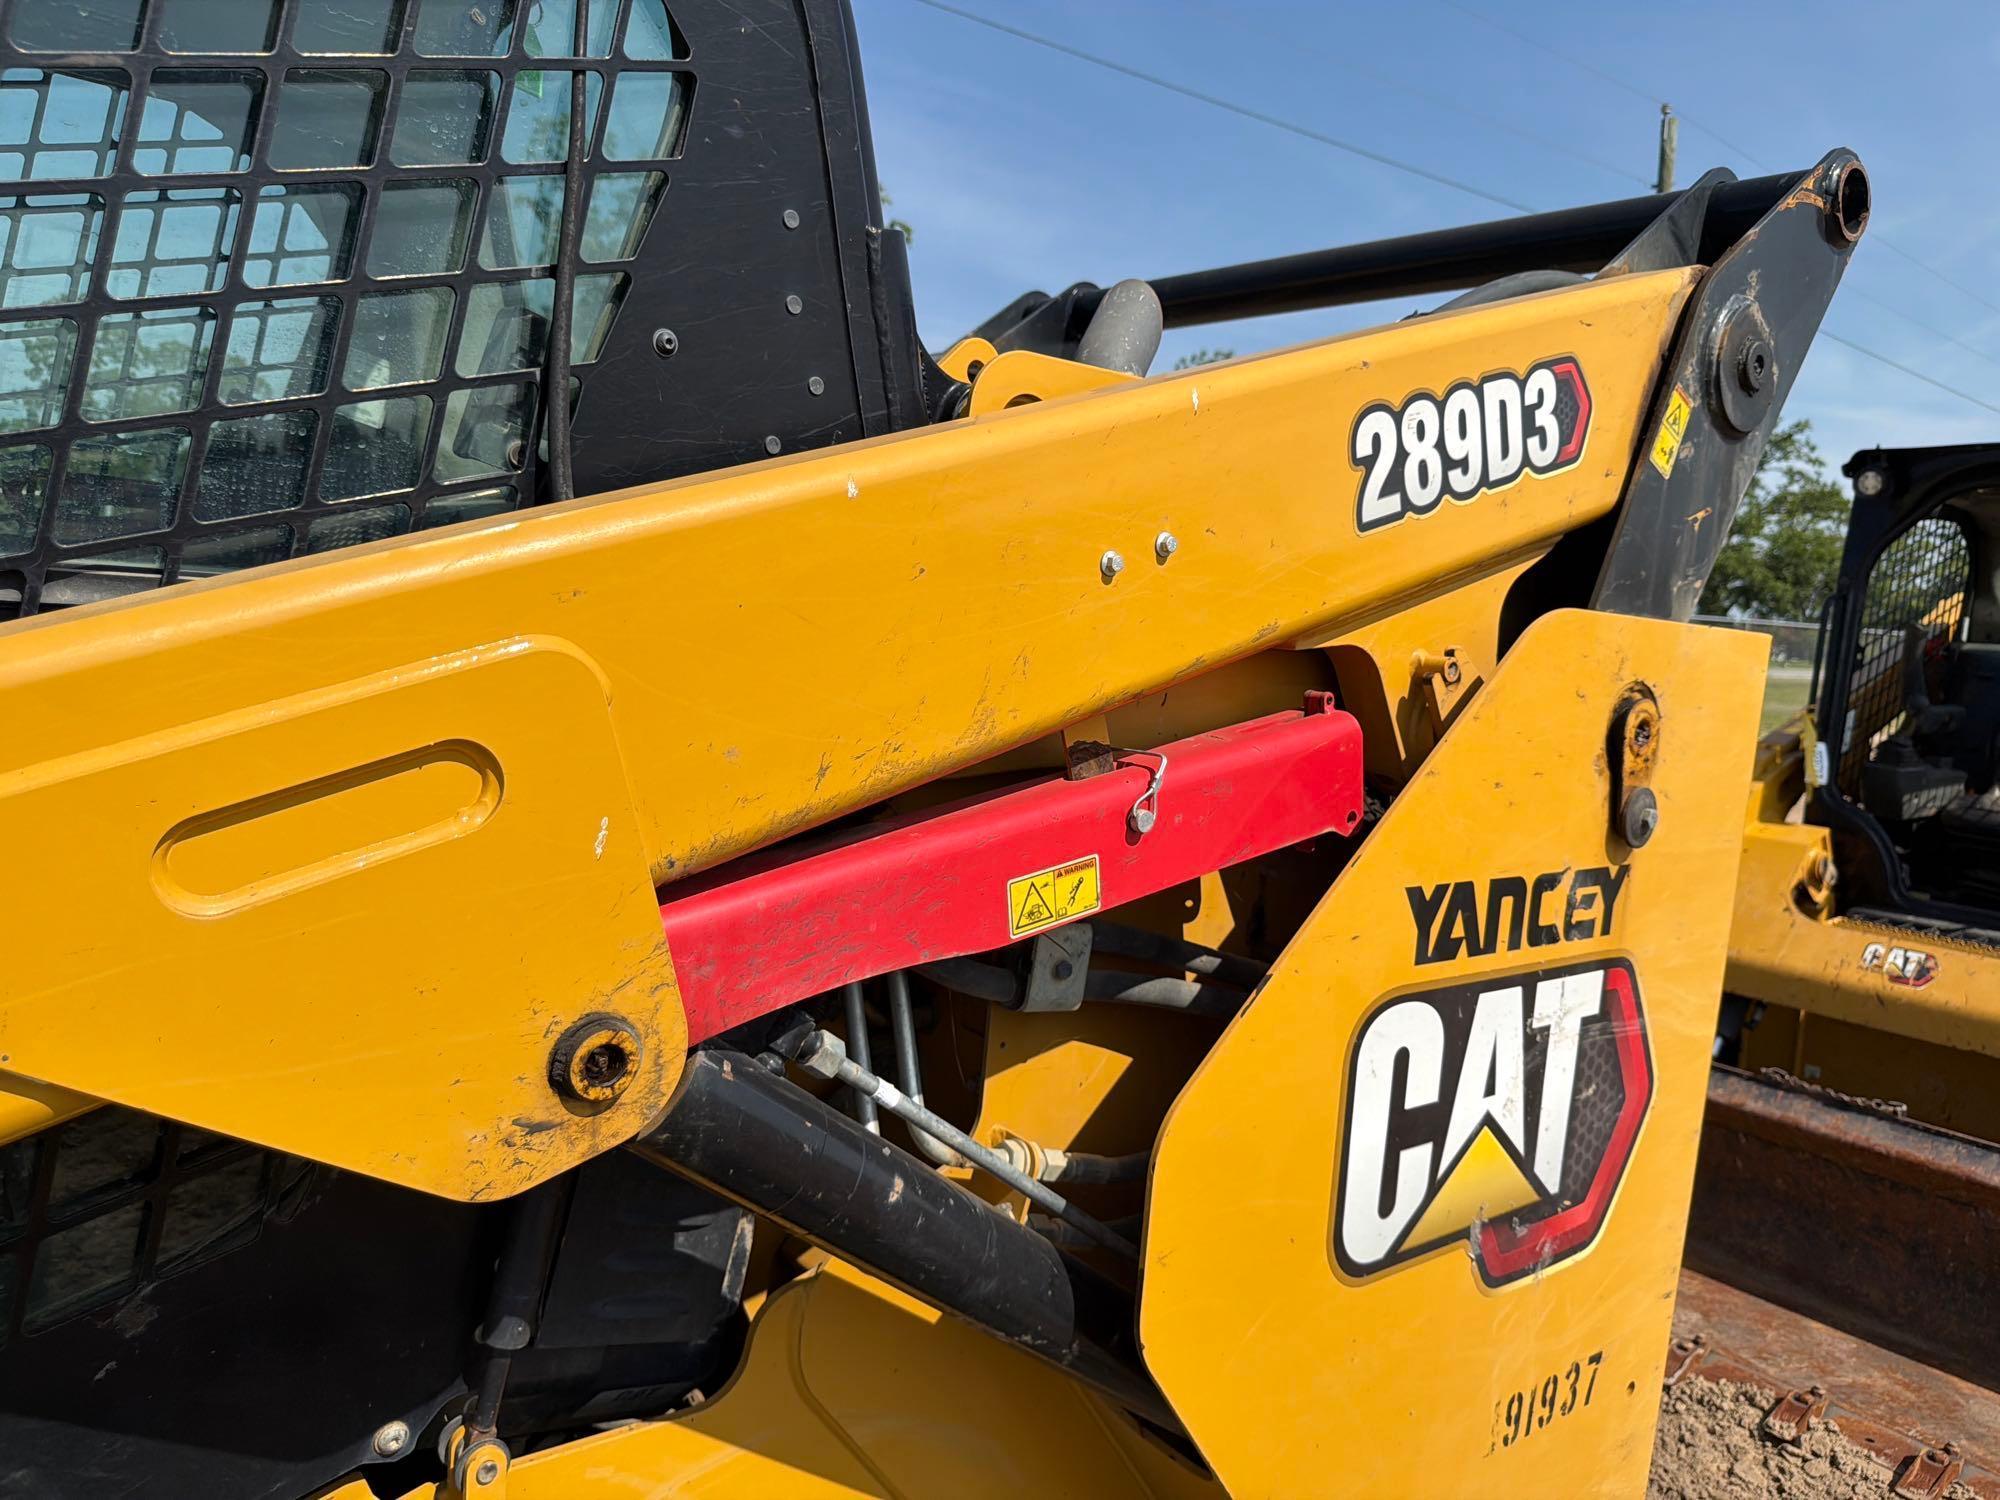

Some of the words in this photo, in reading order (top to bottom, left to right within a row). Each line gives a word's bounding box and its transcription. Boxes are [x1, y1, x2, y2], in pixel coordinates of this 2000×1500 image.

[1356, 369, 1560, 523] 289D3
[1063, 861, 1094, 876] WARNING
[1405, 864, 1630, 966] YANCEY
[1342, 969, 1605, 1265] CAT
